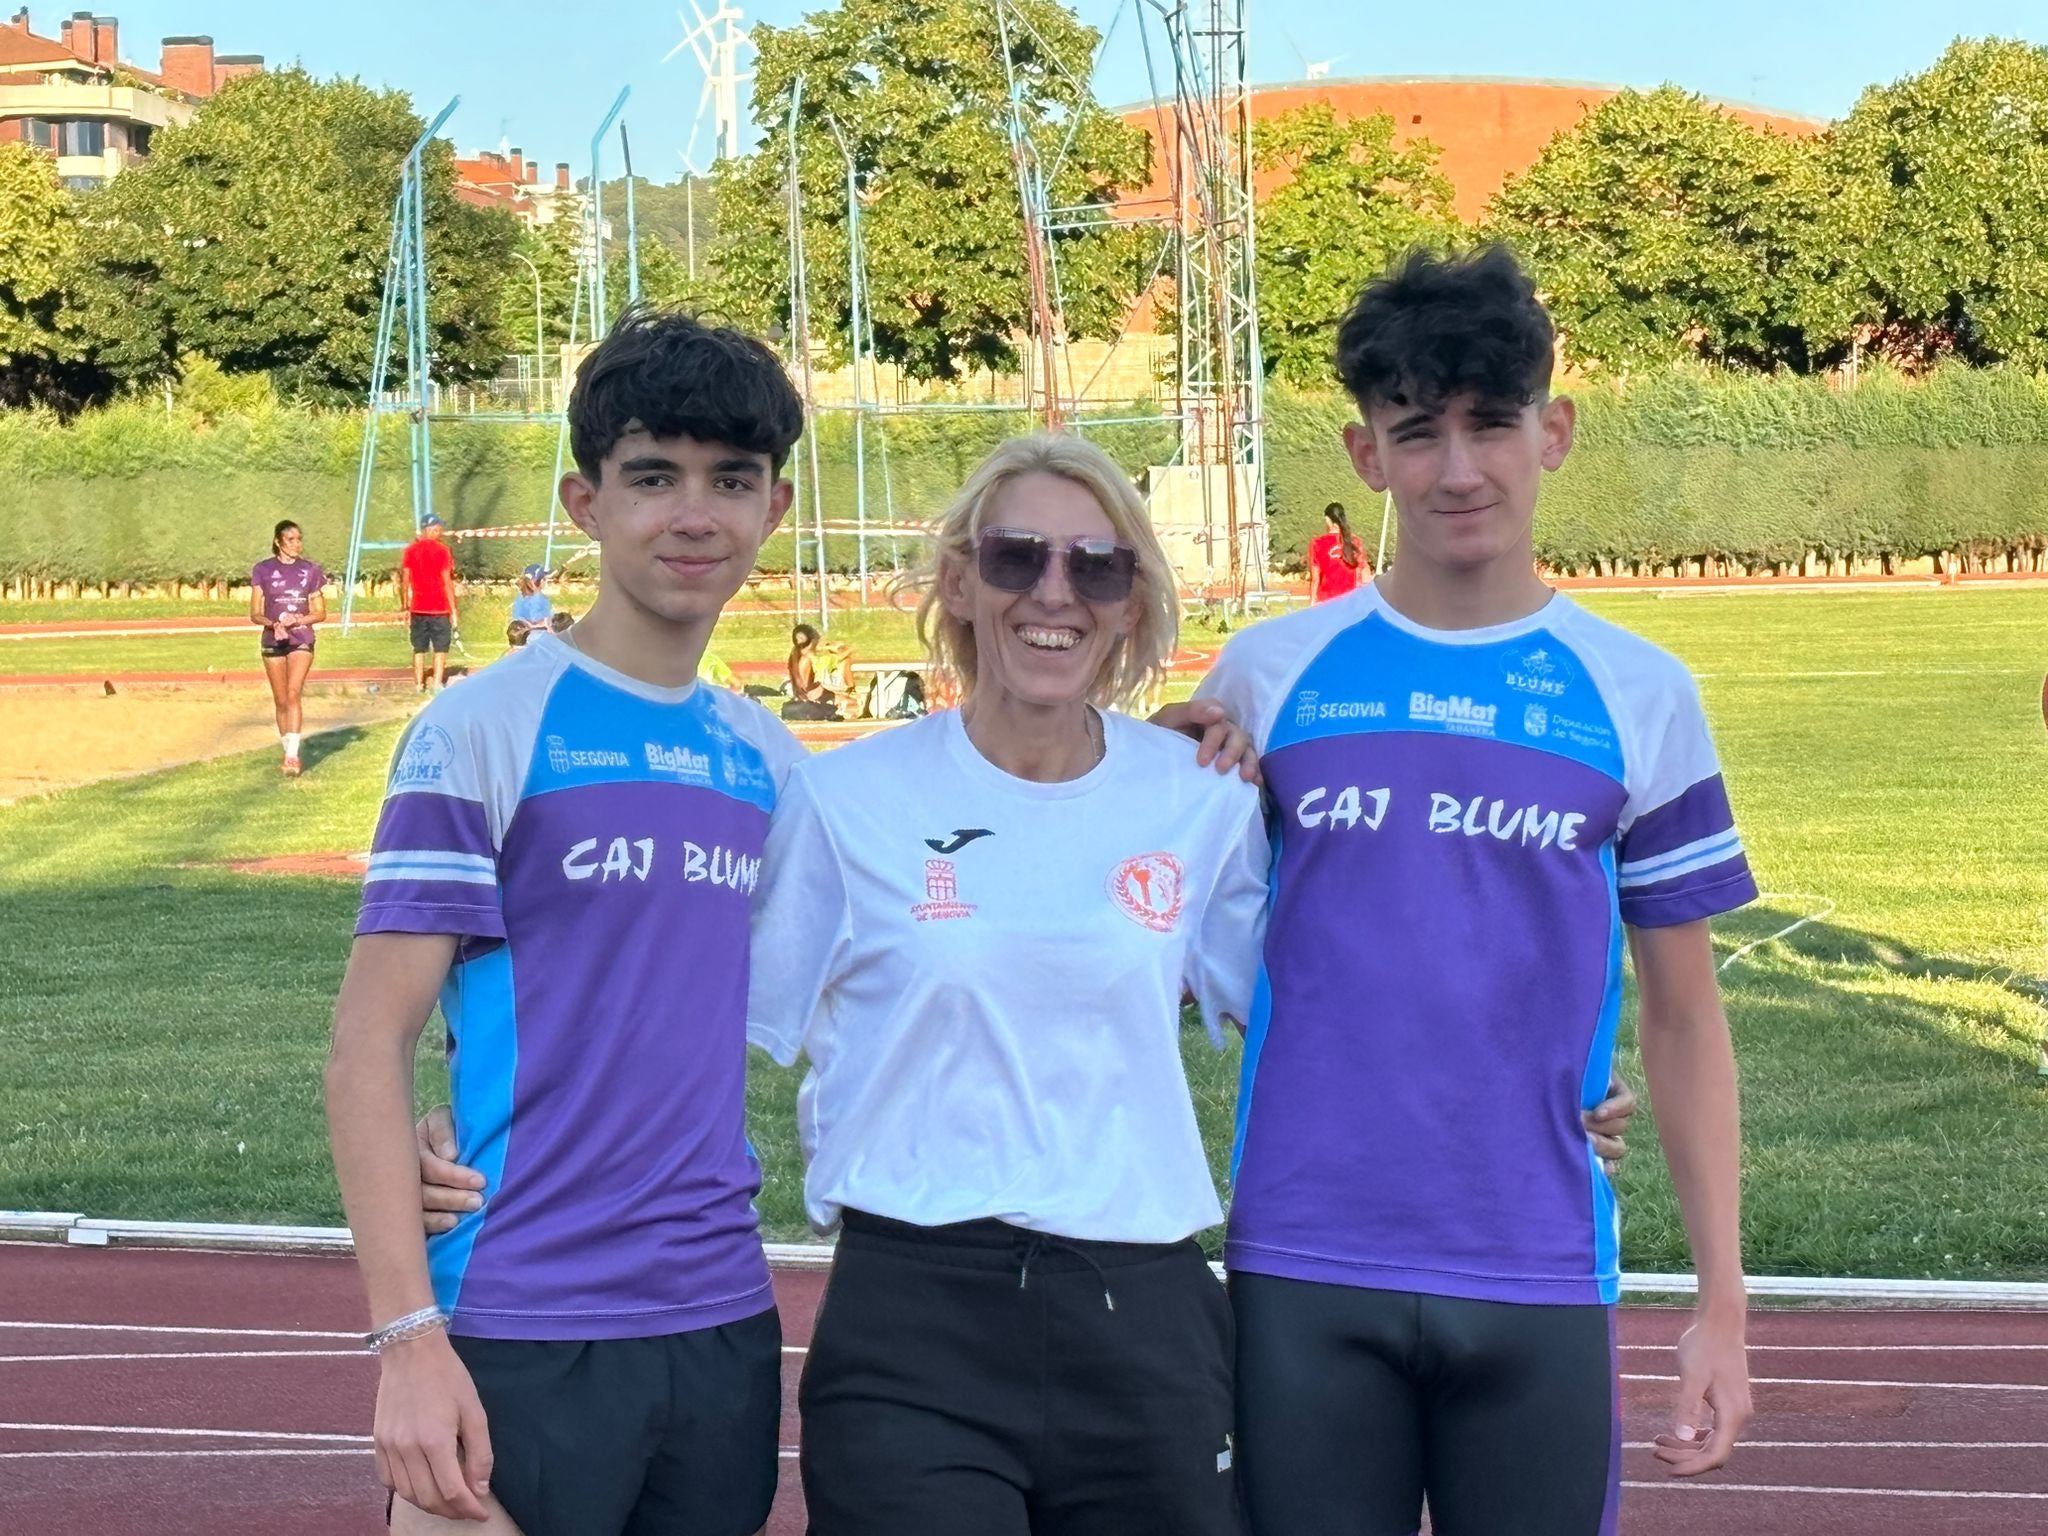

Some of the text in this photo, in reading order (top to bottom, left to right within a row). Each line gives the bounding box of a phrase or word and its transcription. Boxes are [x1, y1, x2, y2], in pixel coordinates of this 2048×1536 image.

[1505, 670, 1566, 695] BLUME
[1319, 701, 1385, 719] SEGOVIA
[1408, 691, 1497, 722] BigMat
[571, 750, 630, 767] SEGOVIA
[645, 742, 710, 772] BigMat
[1296, 785, 1587, 851] CAJ BLUME
[562, 836, 762, 897] CAJ BLUM
